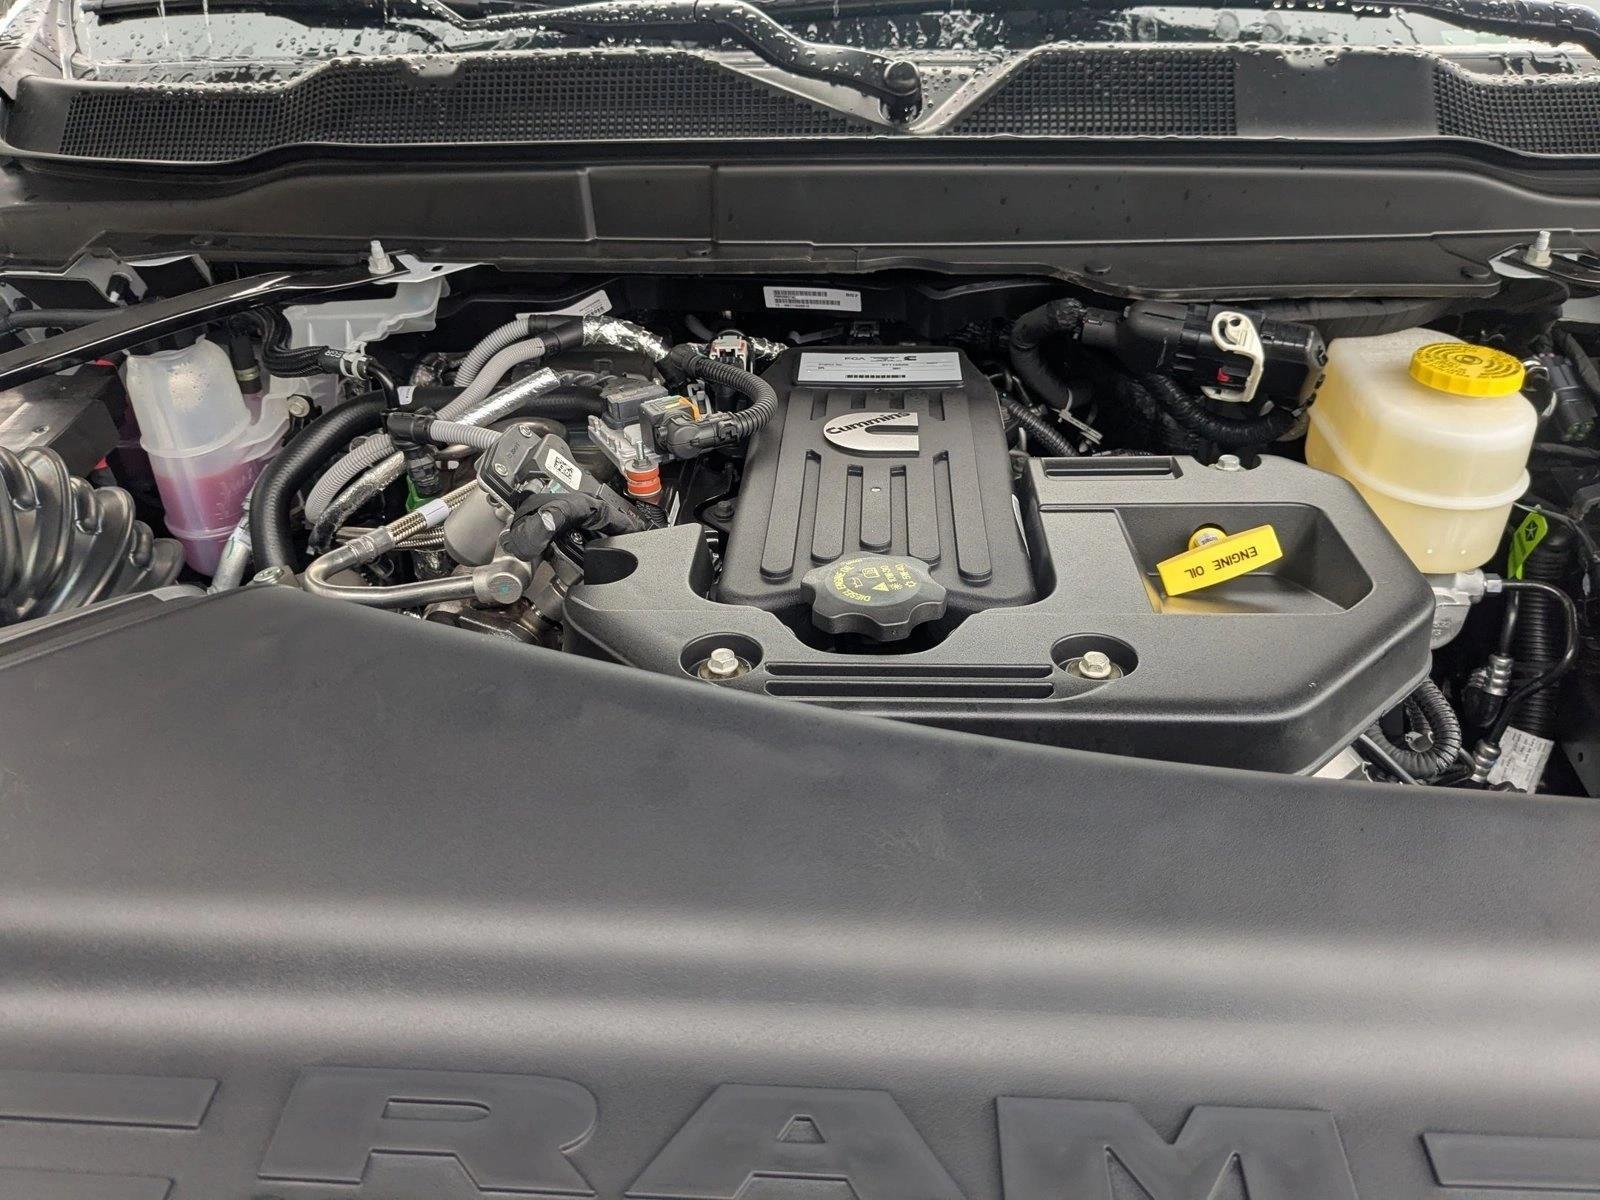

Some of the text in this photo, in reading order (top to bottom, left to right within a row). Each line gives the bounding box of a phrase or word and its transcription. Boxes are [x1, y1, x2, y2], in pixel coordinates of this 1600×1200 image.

[825, 411, 911, 435] Cummins
[1184, 546, 1258, 579] ENGINE OIL
[843, 589, 871, 602] DIESEL
[257, 1064, 1360, 1200] RAM
